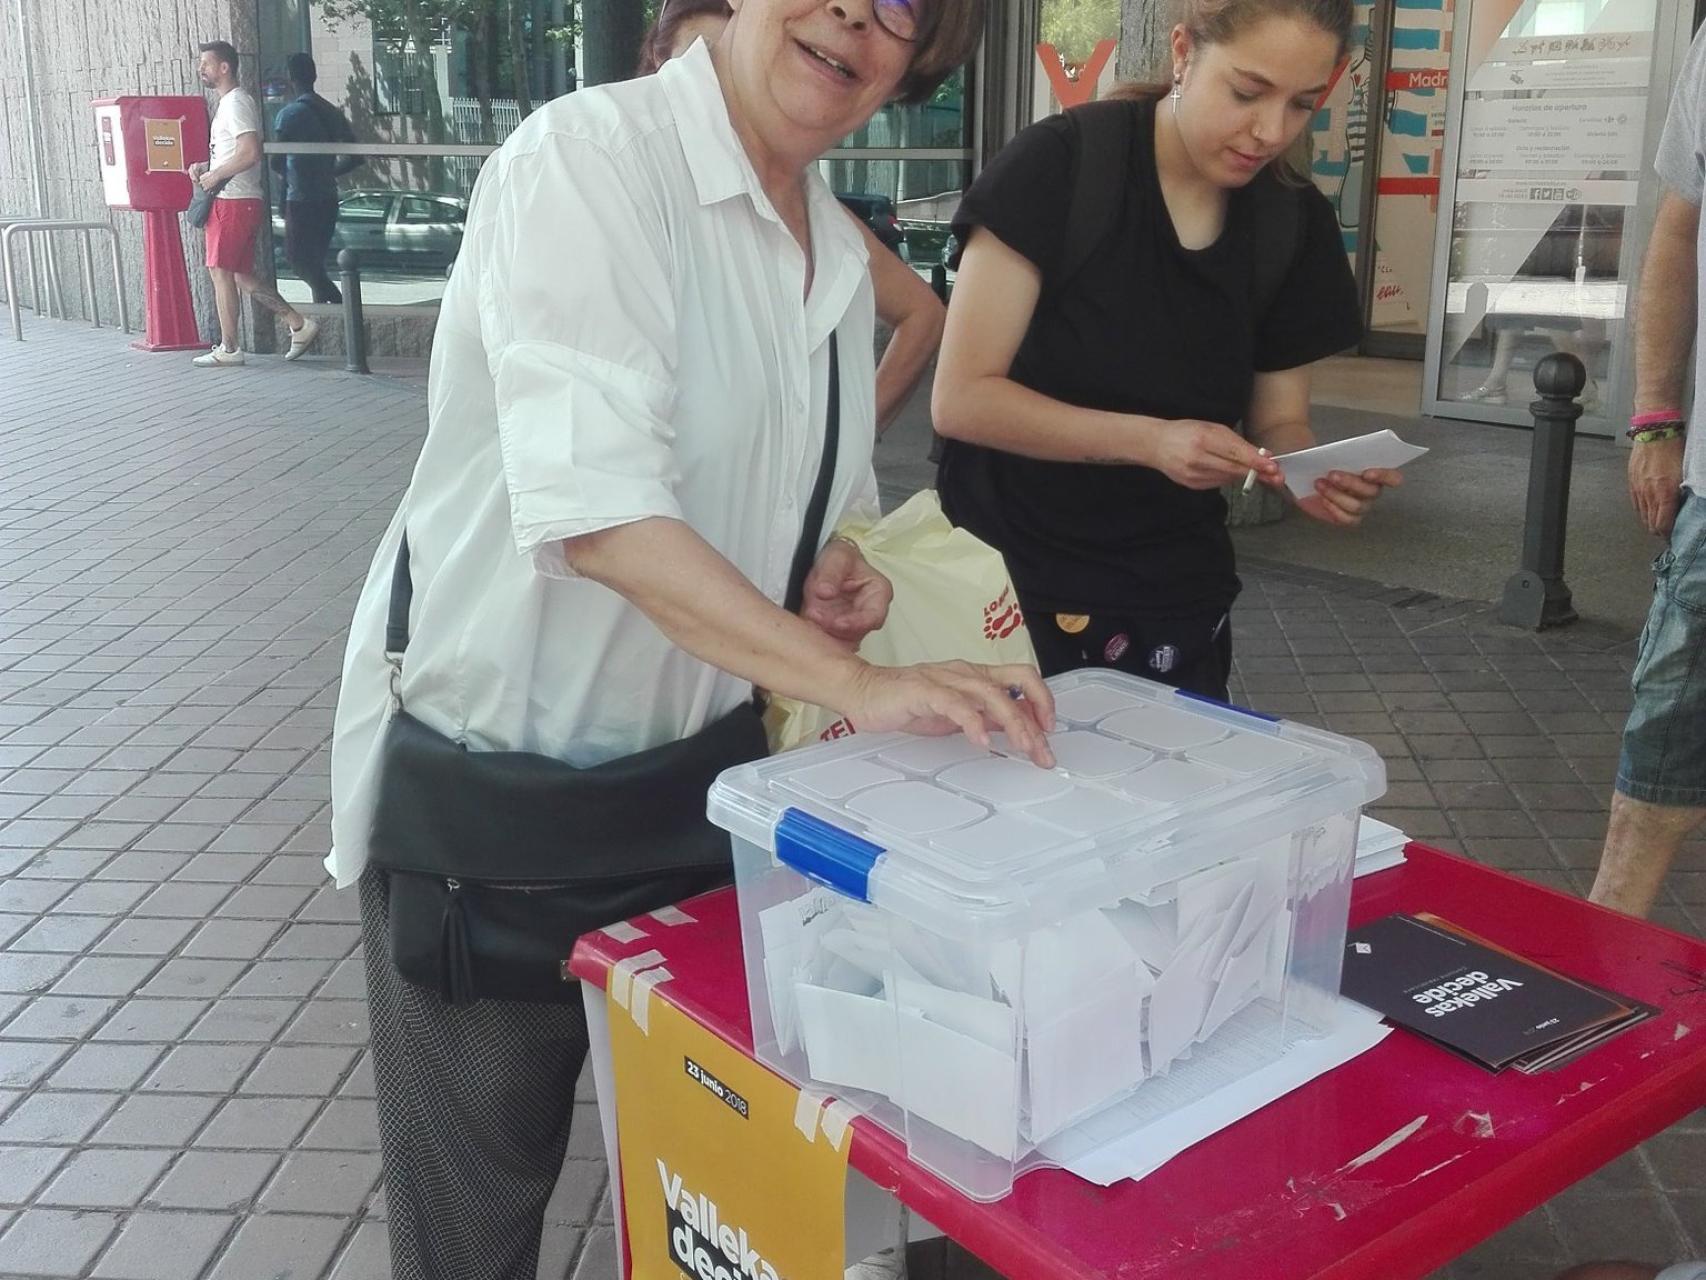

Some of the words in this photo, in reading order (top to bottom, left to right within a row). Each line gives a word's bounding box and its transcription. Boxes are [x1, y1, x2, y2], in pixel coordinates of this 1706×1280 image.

[1408, 71, 1449, 88] Madr
[1411, 970, 1489, 1004] decide
[1424, 978, 1525, 1018] Vallekas
[686, 1060, 700, 1079] 23
[699, 1069, 724, 1097] junio
[724, 1089, 747, 1116] 2018
[656, 1157, 782, 1280] Valleka
[672, 1224, 743, 1280] de
